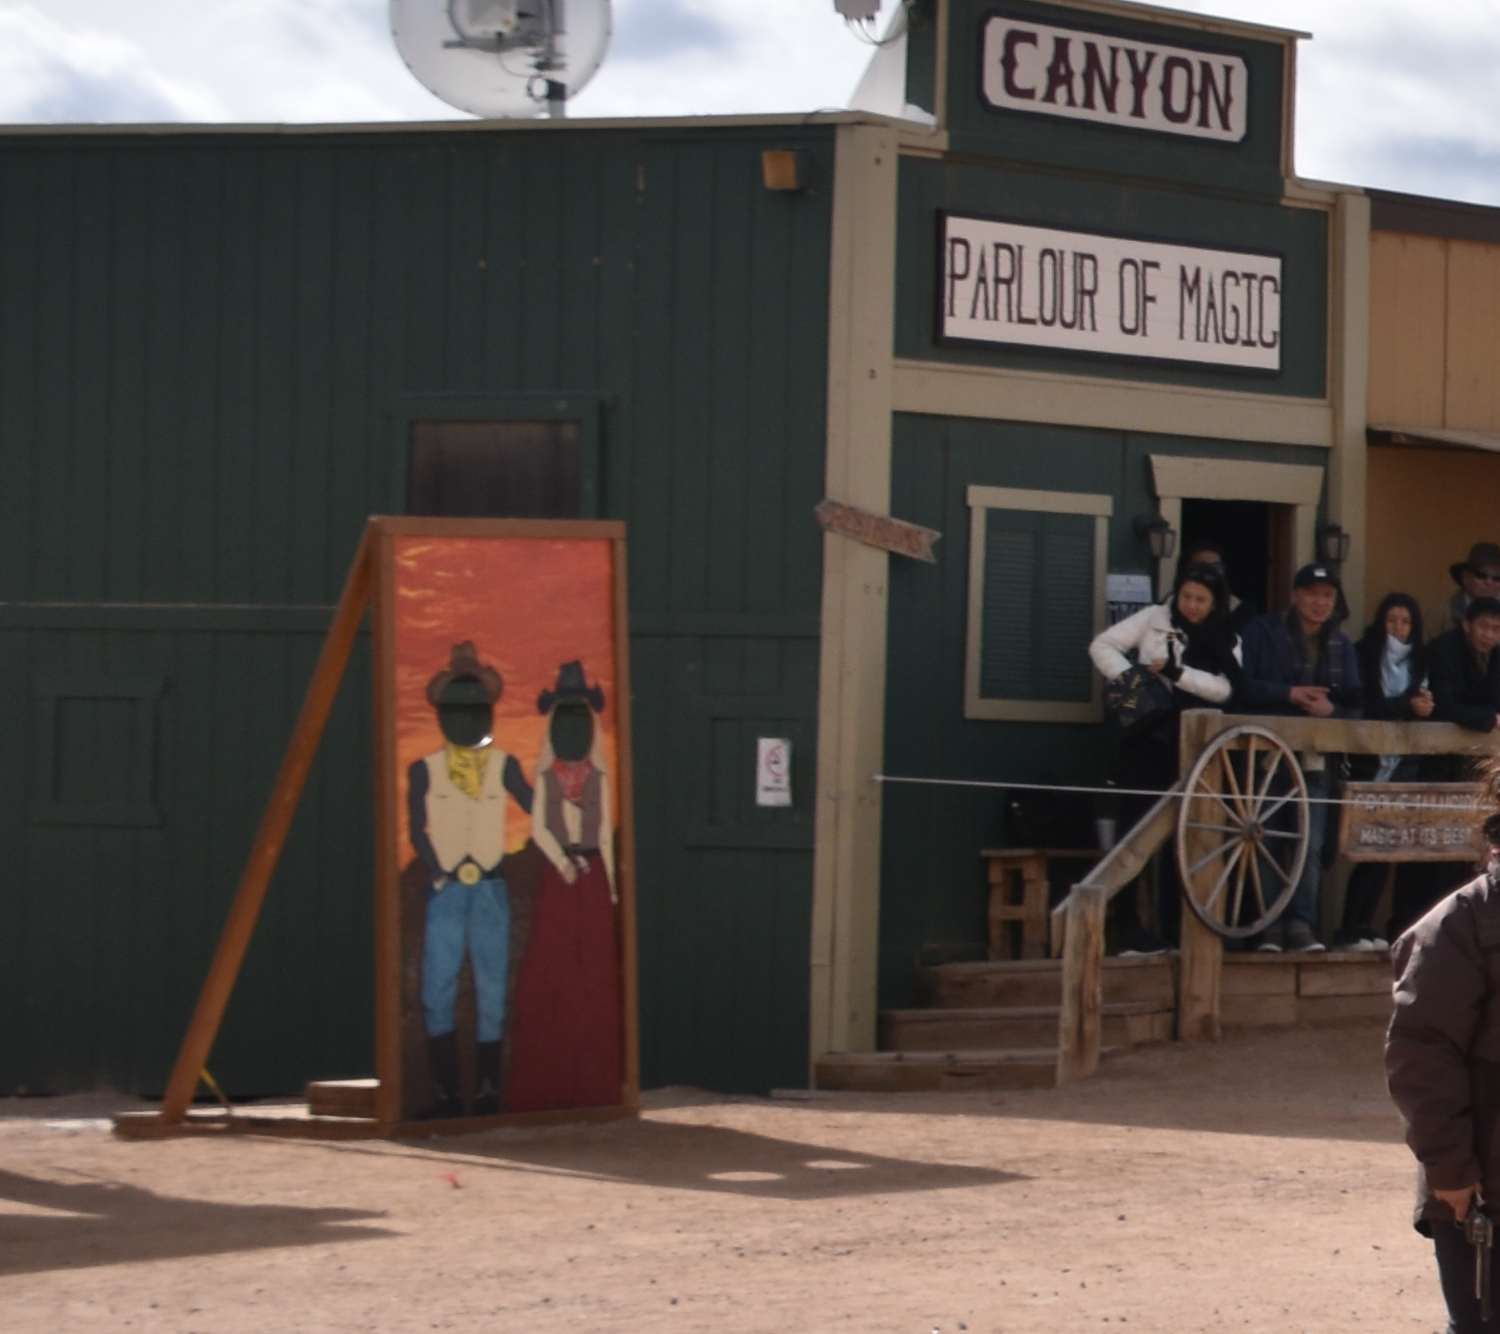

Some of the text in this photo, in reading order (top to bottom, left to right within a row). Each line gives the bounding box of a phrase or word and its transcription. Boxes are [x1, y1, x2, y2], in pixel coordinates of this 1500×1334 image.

[1000, 29, 1234, 131] CANYON
[948, 236, 1281, 350] PARLOUR OF MAGIC
